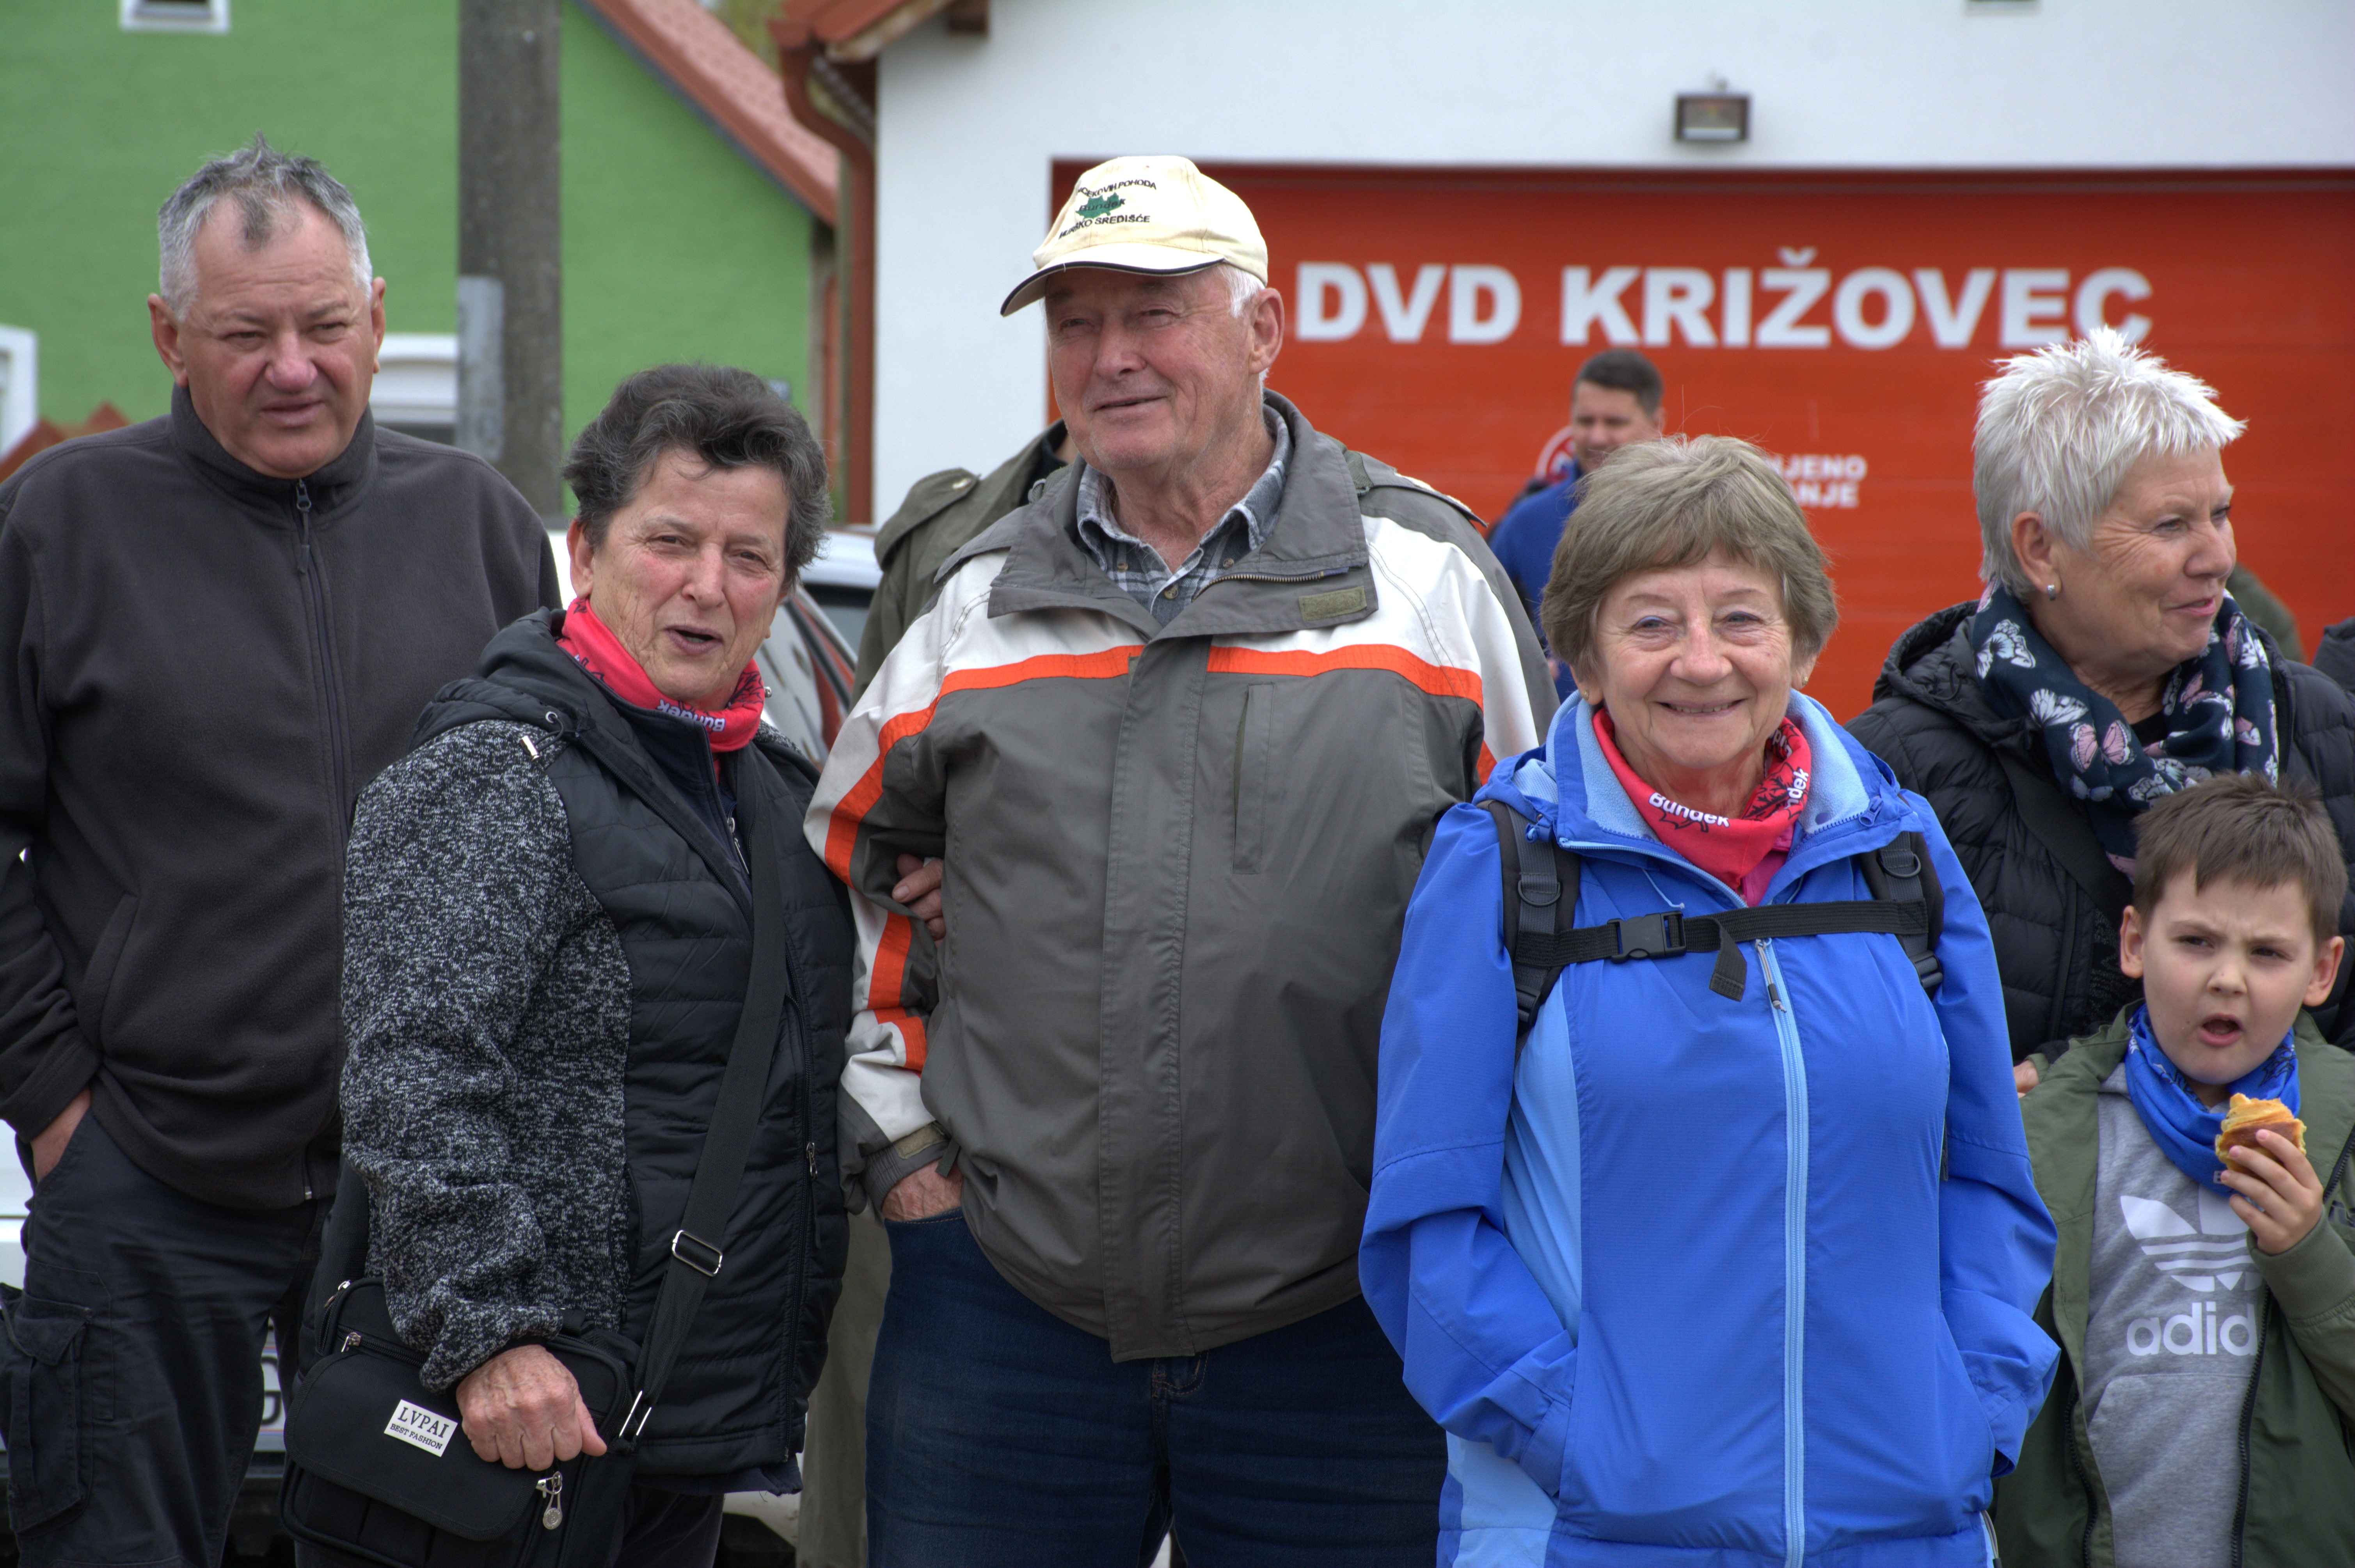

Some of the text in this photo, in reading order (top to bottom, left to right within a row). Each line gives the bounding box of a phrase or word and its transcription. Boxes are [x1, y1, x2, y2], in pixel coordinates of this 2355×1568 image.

[1118, 179, 1157, 190] POHODA
[1079, 198, 1126, 212] Bundek
[1095, 214, 1151, 225] SREDIŠĆE
[1296, 247, 2153, 348] DVD KRIŽOVEC
[1792, 481, 1859, 508] NJE
[1648, 791, 1730, 828] Bundek
[398, 1407, 449, 1438] LVPAI
[390, 1423, 443, 1450] BEST FASHION
